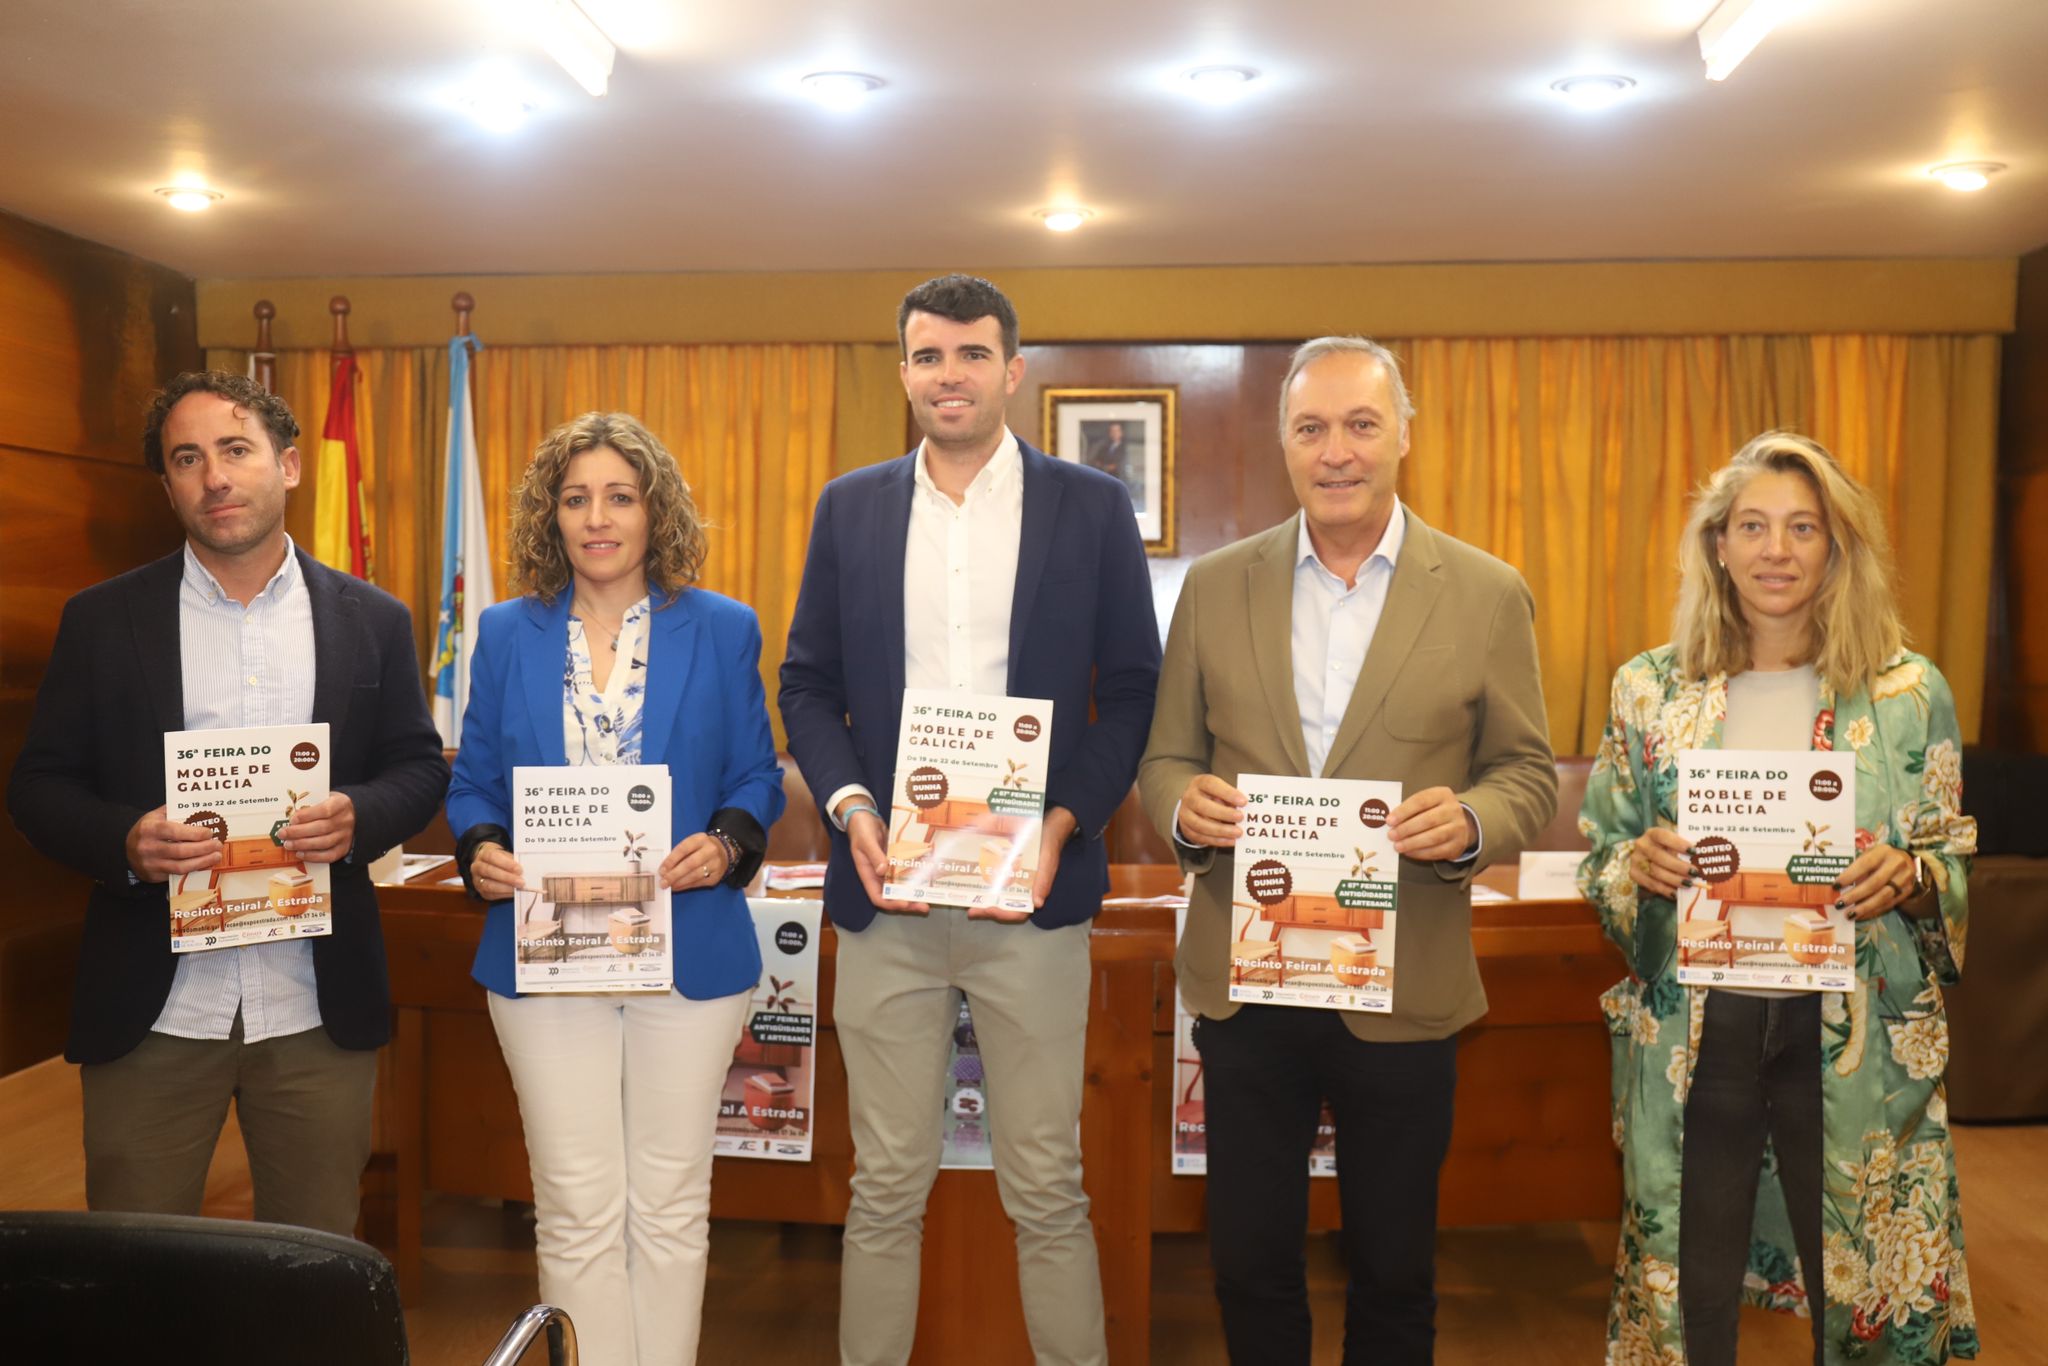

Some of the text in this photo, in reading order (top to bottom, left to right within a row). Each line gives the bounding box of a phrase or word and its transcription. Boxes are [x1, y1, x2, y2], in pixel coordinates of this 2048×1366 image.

[936, 708, 973, 719] FEIRA
[978, 713, 997, 721] DO
[910, 724, 994, 739] MOBLE DE
[909, 736, 976, 750] GALICIA
[204, 747, 246, 758] FEIRA
[251, 745, 271, 755] DO
[962, 760, 998, 768] Setembro
[177, 764, 271, 779] MOBLE DE
[1717, 770, 1760, 780] FEIRA
[1766, 770, 1788, 780] DO
[177, 778, 252, 792] GALICIA
[549, 787, 586, 796] FEIRA
[591, 787, 610, 795] DO
[1011, 791, 1030, 799] FEIRA
[1689, 789, 1786, 800] MOBLE DE
[239, 797, 278, 805] Setembro
[1274, 795, 1315, 806] FEIRA
[1320, 797, 1340, 807] DO
[525, 805, 609, 814] MOBLE DE
[1689, 803, 1766, 814] GALICIA
[186, 817, 220, 827] ORTEO
[525, 817, 592, 827] GALICIA
[1247, 813, 1338, 827] MOBLE DE
[1247, 827, 1319, 840] GALICIA
[1698, 854, 1731, 864] DUNHA
[938, 862, 970, 873] Feiral
[1251, 868, 1285, 876] SORTEO
[1702, 865, 1731, 875] VIAXE
[1791, 866, 1845, 874] ANTIGÜIDADE
[1254, 878, 1285, 887] DUNHA
[1257, 888, 1283, 896] VIAXE
[1339, 891, 1393, 899] ANTIGÜIDADES
[174, 907, 223, 919] Recinto
[227, 902, 260, 912] Feiral
[278, 895, 323, 907] Estrada
[1352, 900, 1392, 908] ARTESANÍA
[521, 935, 659, 947] Recinto Feiral A Estrada
[1681, 939, 1845, 954] Recinto Feiral A Estrada
[1234, 958, 1386, 977] Recinto Feiral A Estrada
[754, 1024, 810, 1033] ANTIGÜIDADES
[738, 1106, 748, 1115] A
[752, 1106, 804, 1119] Estrada
